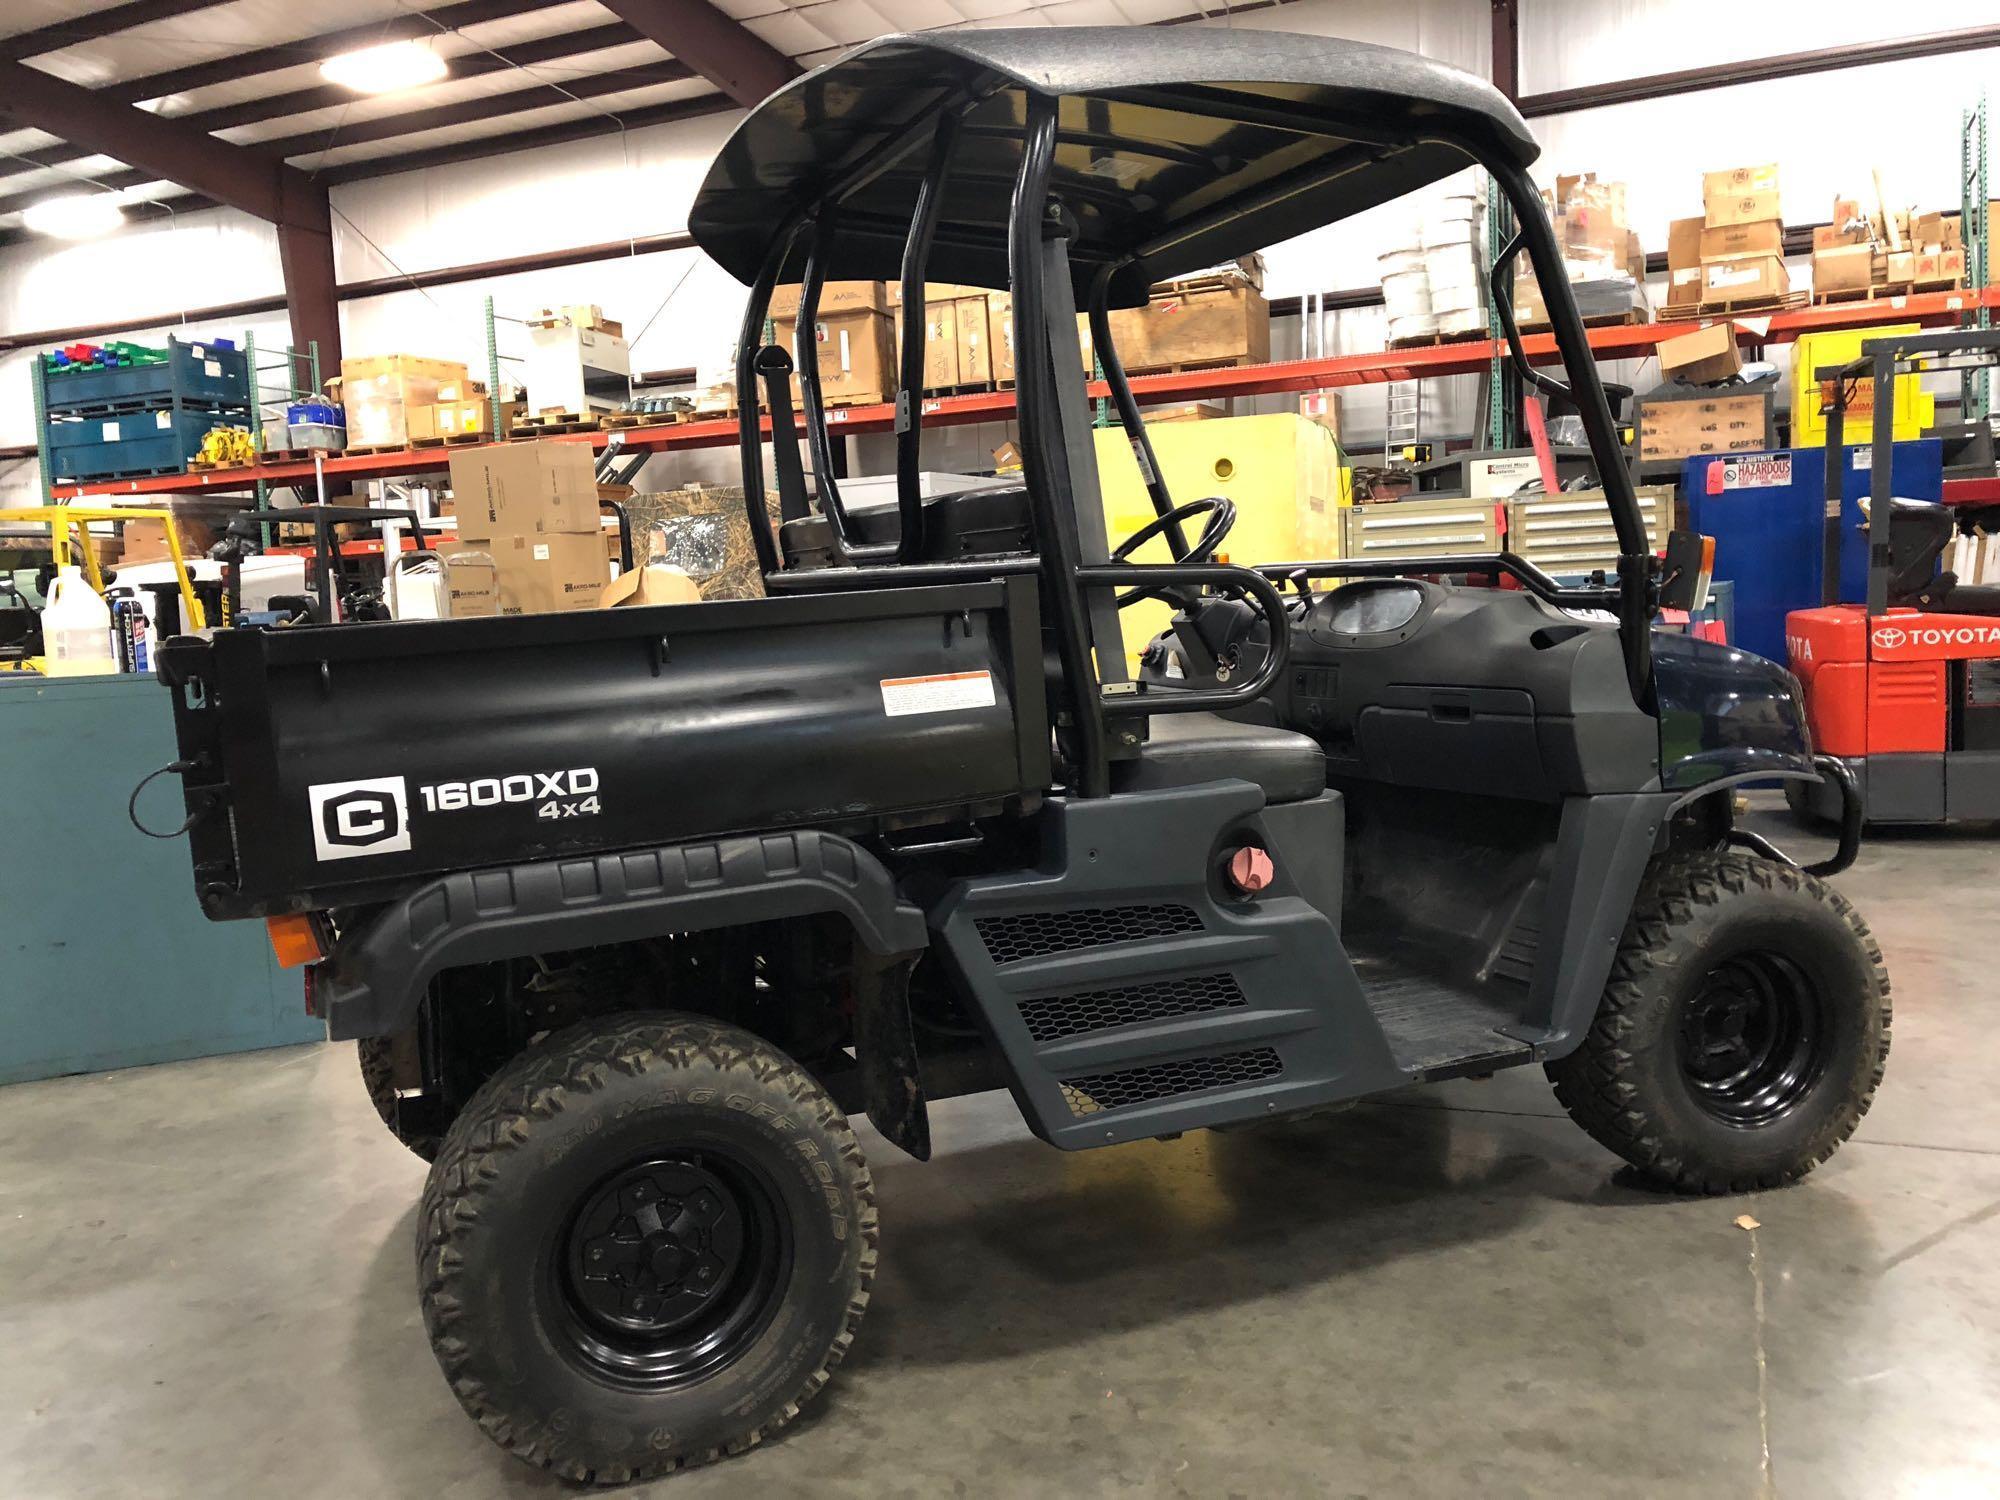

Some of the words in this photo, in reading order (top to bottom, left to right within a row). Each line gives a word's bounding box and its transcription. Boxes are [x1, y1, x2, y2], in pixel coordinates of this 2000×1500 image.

[472, 382, 486, 394] 3M
[1738, 462, 1791, 476] HAZARDOUS
[1908, 628, 2000, 645] TOYOTA
[420, 767, 599, 812] 1600XD
